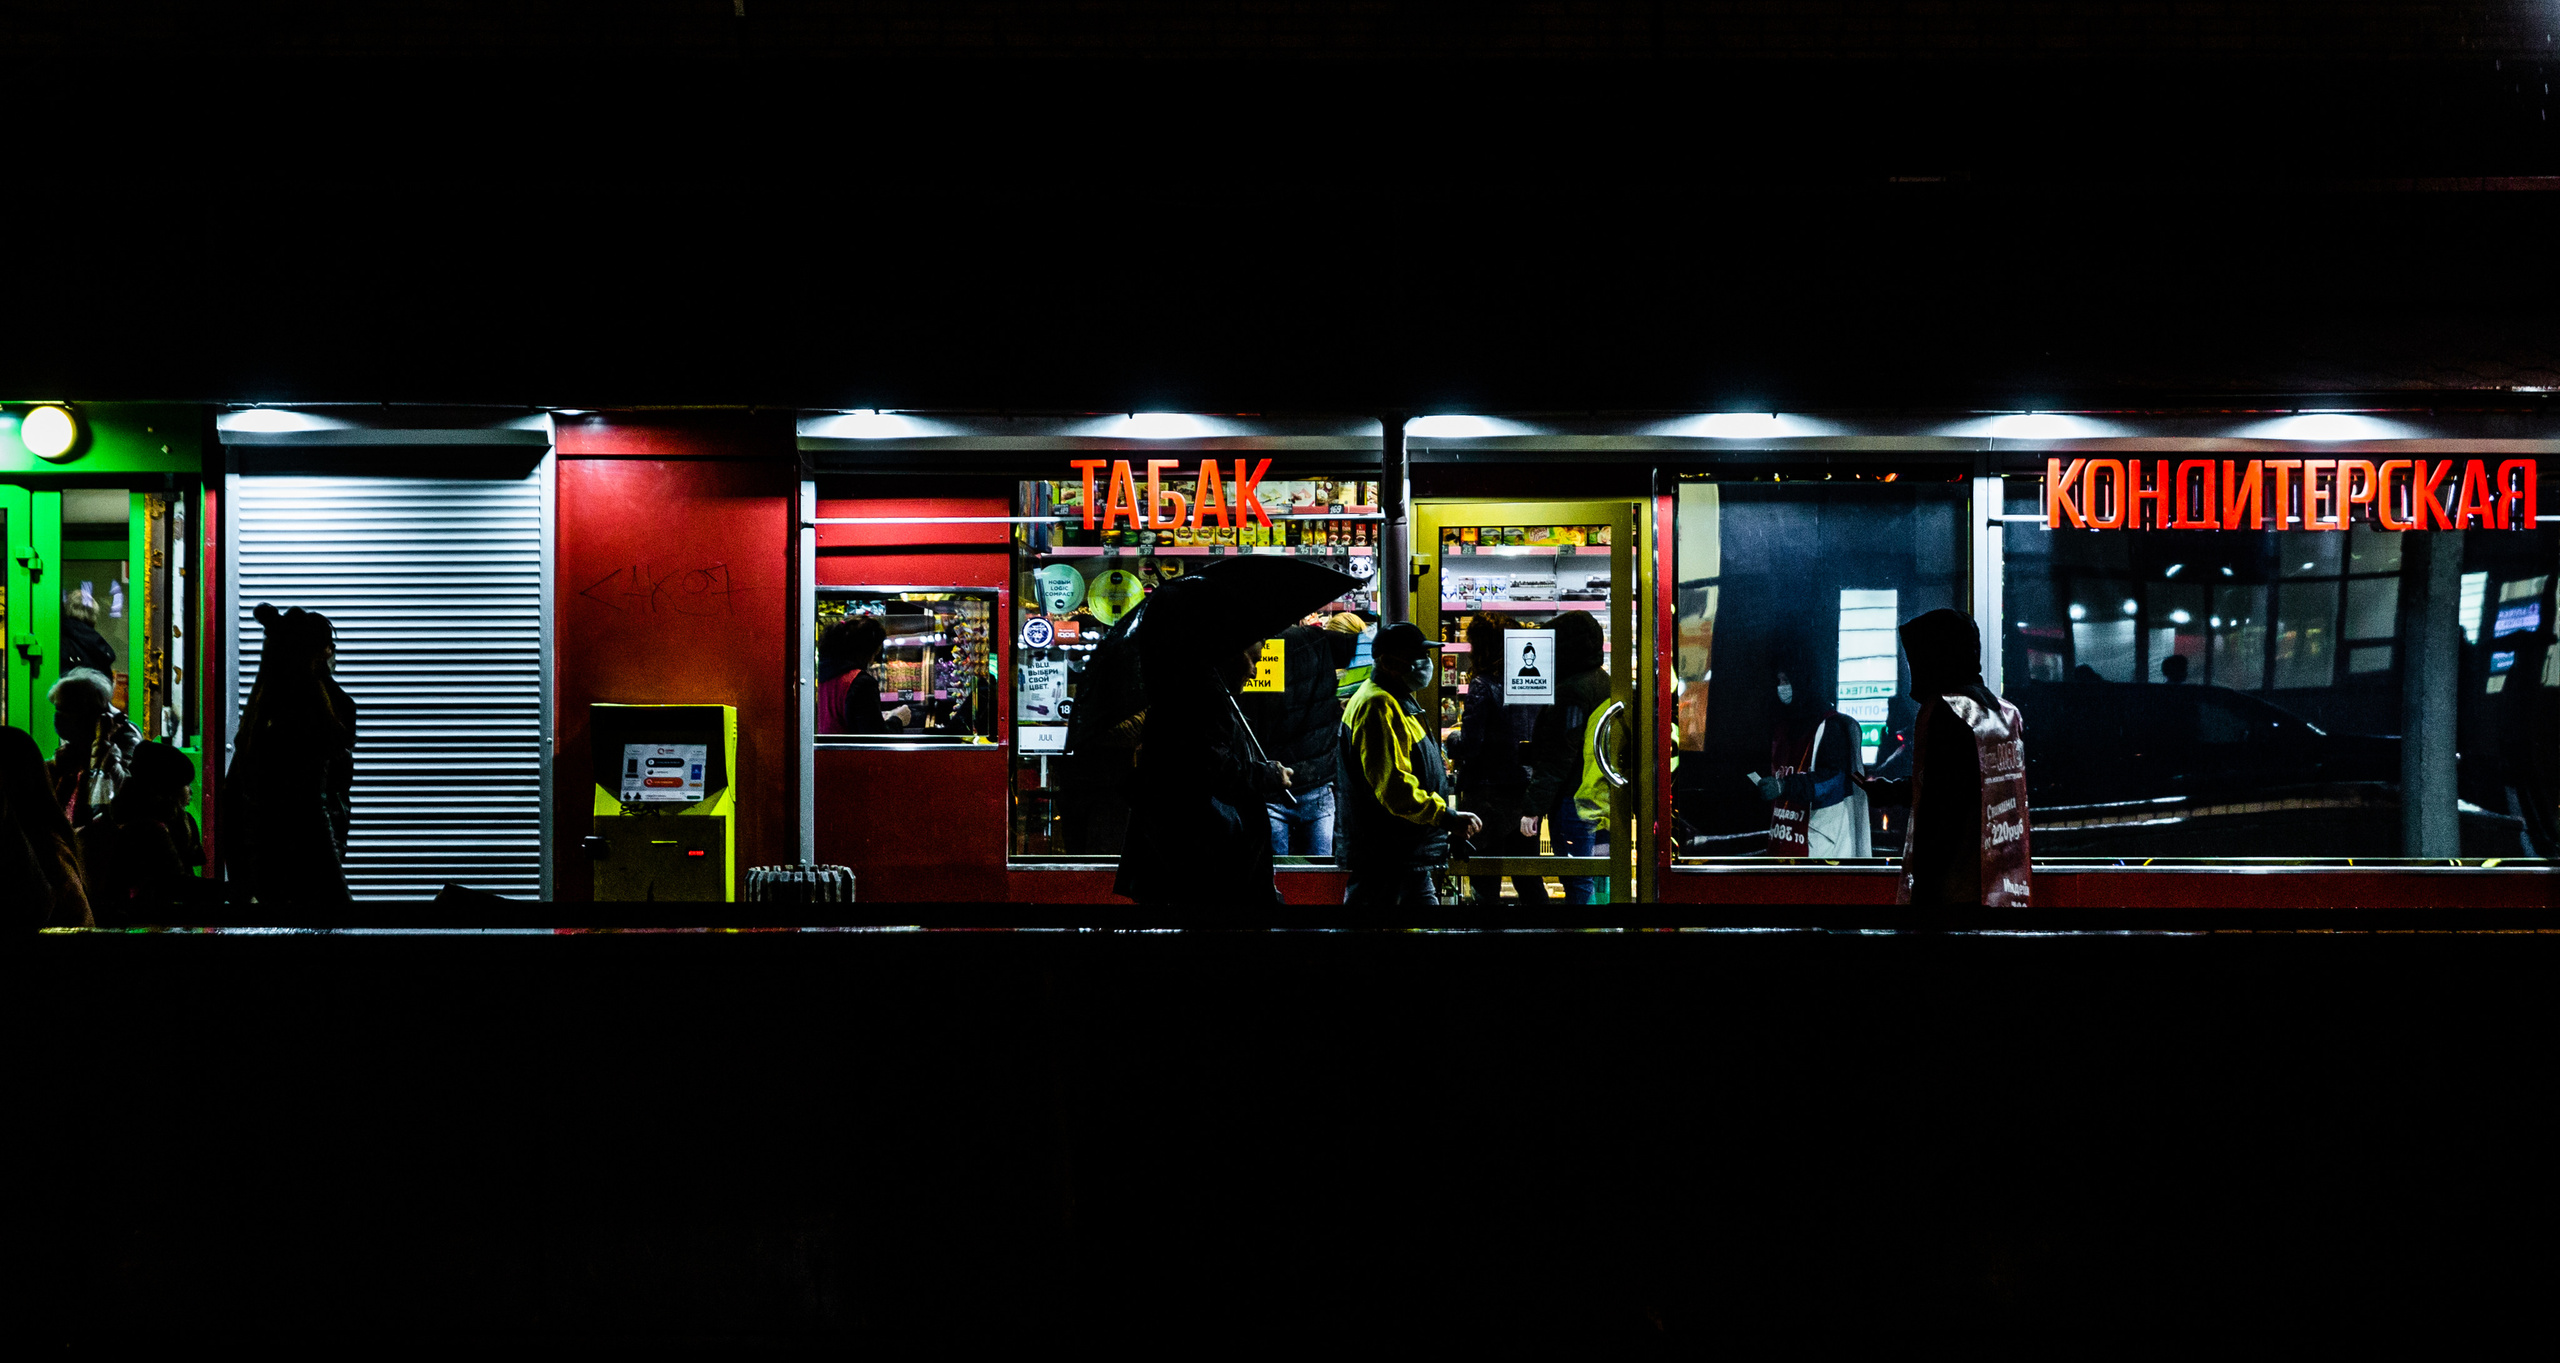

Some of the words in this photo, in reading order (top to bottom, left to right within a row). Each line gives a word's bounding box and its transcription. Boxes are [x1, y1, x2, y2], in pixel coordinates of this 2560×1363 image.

[1070, 458, 1274, 531] ТАБАК
[2047, 458, 2538, 532] КОНДИТЕРСКАЯ
[1028, 668, 1059, 677] ВЫБЕРИ
